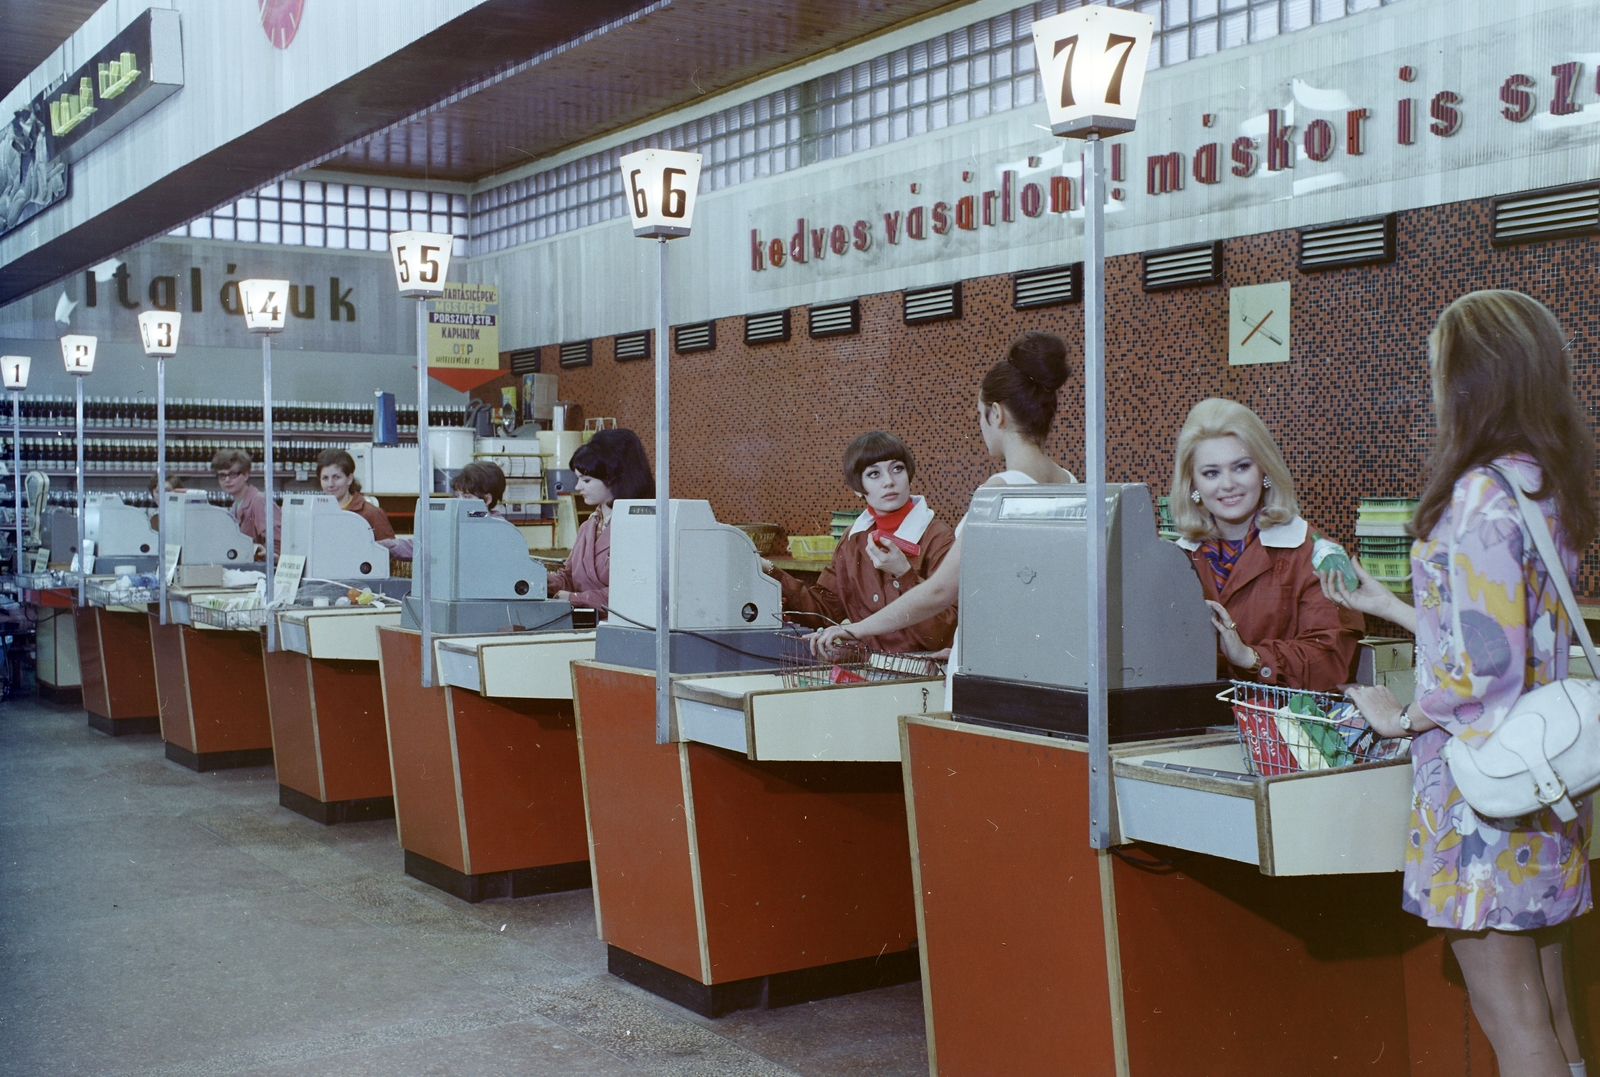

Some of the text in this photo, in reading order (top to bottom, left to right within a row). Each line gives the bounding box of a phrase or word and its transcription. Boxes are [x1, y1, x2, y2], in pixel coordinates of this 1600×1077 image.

[1052, 34, 1079, 108] 7
[1104, 33, 1137, 106] 7
[750, 61, 1600, 272] kedves vásárlón! máskor is sz
[630, 168, 648, 219] 6
[661, 167, 687, 219] 6
[397, 245, 410, 283] 5
[419, 245, 440, 283] 5
[259, 291, 281, 321] 4
[475, 315, 494, 326] STB.
[157, 322, 172, 347] 3
[441, 325, 480, 340] KAPHATÓK
[453, 343, 473, 355] OTP
[75, 345, 89, 367] 2
[13, 364, 20, 383] 1
